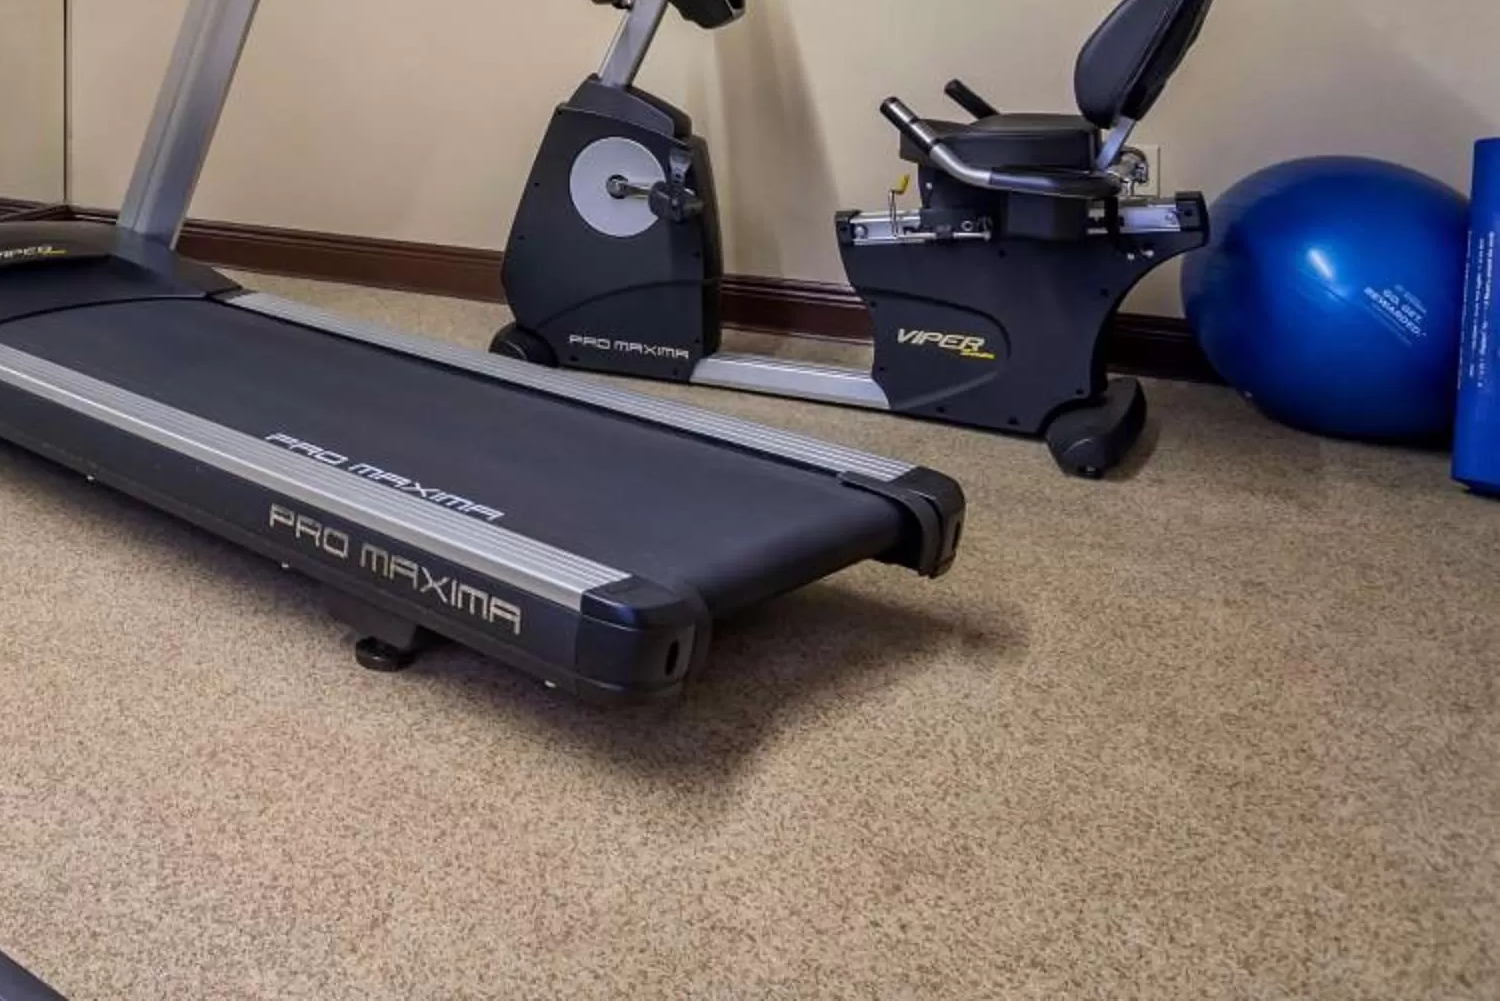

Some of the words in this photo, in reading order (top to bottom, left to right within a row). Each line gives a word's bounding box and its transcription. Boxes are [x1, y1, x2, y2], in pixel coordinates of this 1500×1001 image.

[568, 333, 611, 350] PRO
[613, 339, 689, 360] MAXIMA
[897, 327, 986, 352] VIPER
[265, 431, 349, 467] PRO
[349, 462, 505, 522] MAXIMA
[268, 502, 350, 559] PRO
[358, 541, 523, 636] MAXIMA
